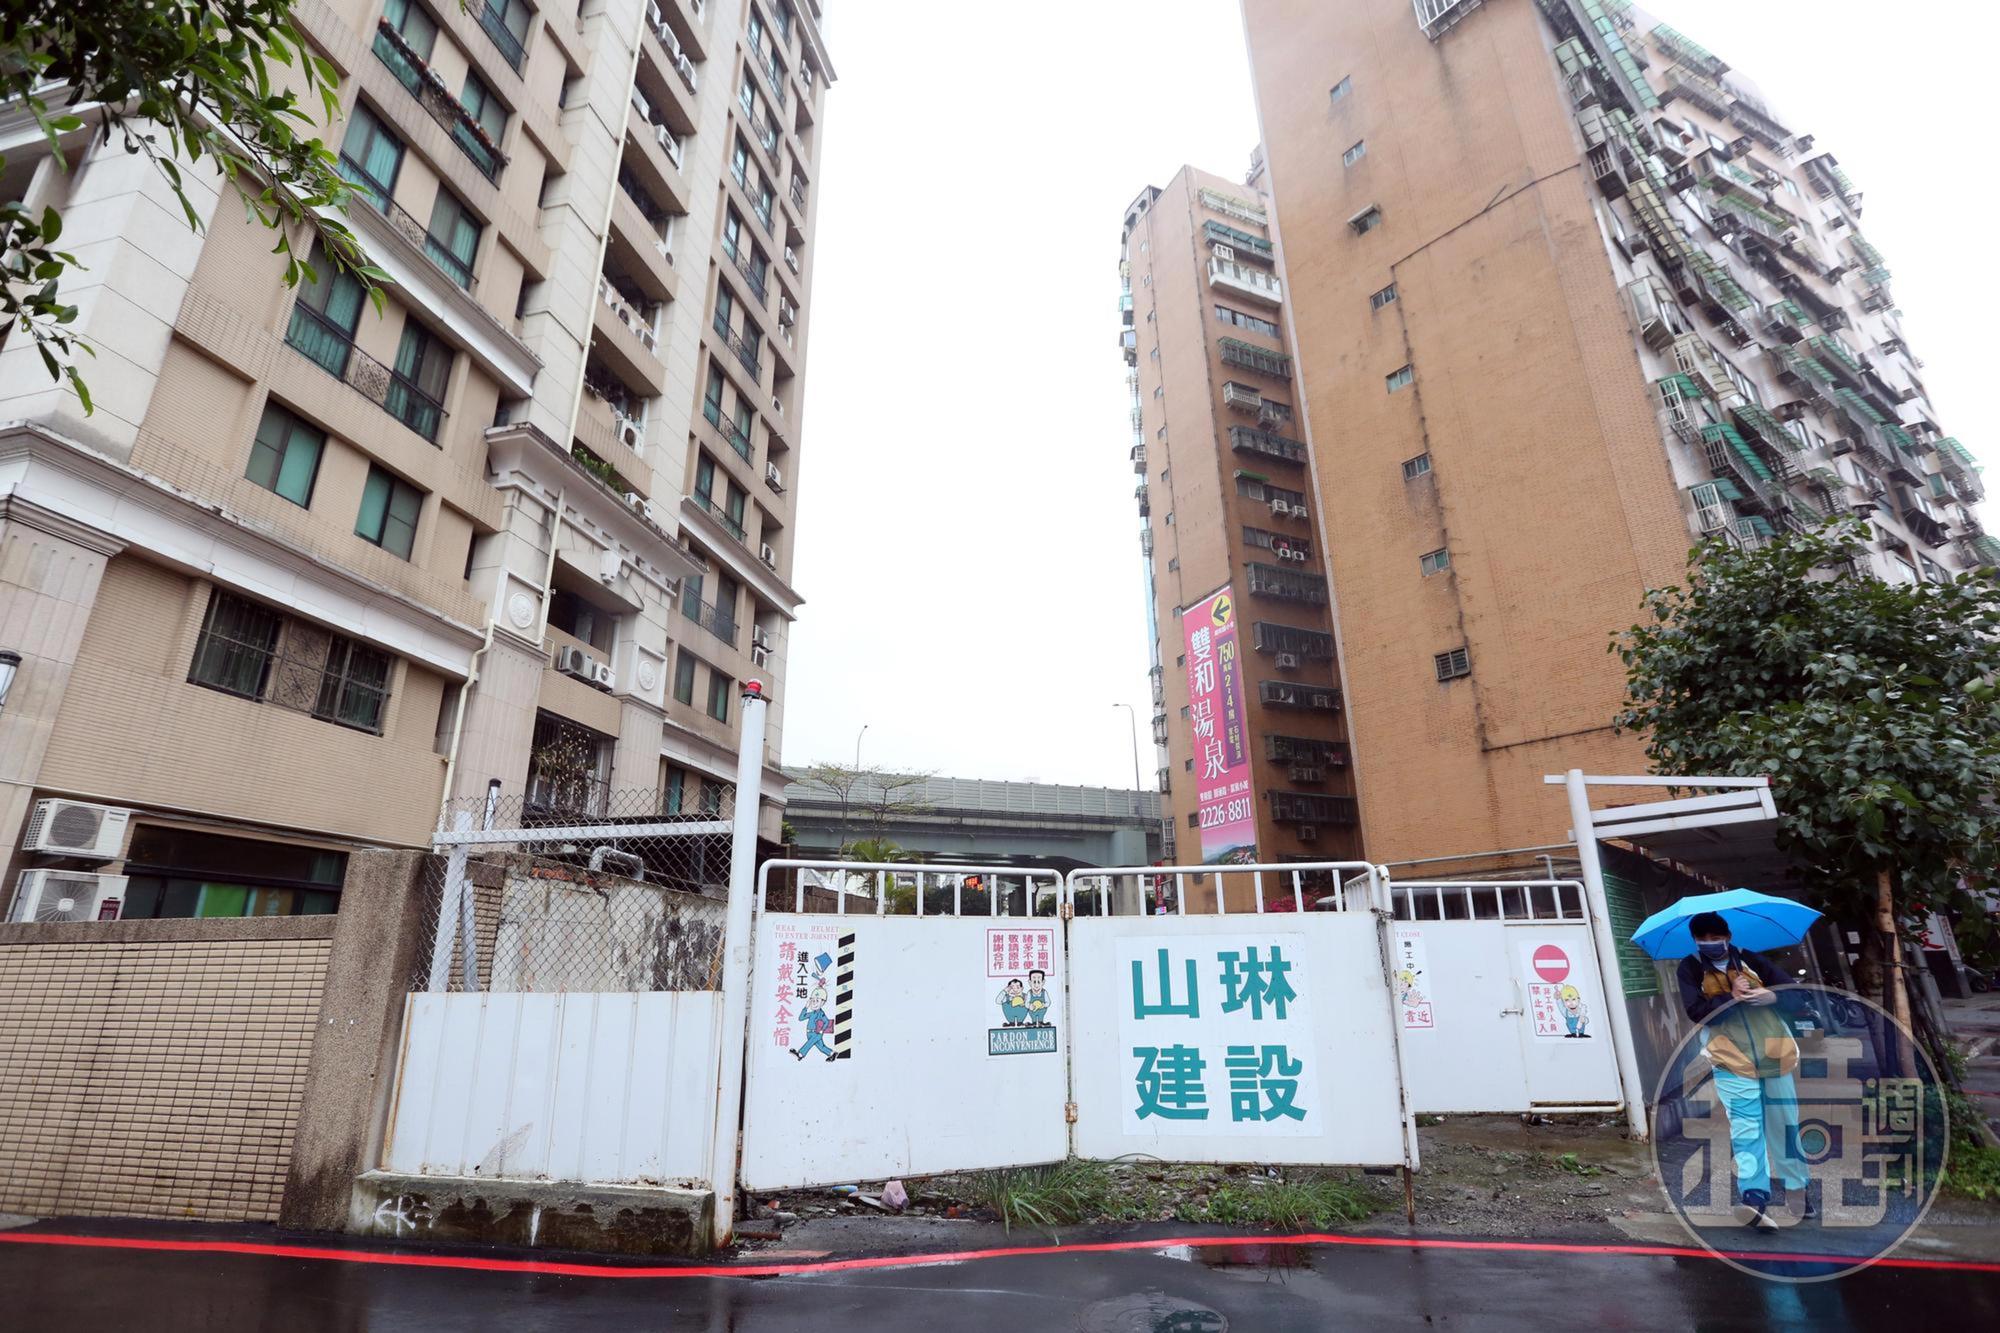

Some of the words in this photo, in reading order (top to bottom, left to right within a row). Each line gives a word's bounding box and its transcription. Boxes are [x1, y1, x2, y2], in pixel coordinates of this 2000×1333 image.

[1217, 640, 1235, 665] 750
[1191, 626, 1230, 780] 雙和湯泉
[810, 925, 839, 933] HELMET
[993, 934, 1005, 970] 謝謝合作
[1008, 934, 1020, 970] 敬請原諒
[1022, 934, 1034, 970] 諸多不便
[1037, 934, 1049, 969] 施工期間
[1404, 941, 1414, 969] 施工中
[796, 951, 809, 999] 進入工地
[1131, 945, 1297, 1021] 山琳
[773, 941, 797, 1047] 請戴安全帽
[1531, 985, 1548, 1033] 禁止進入
[990, 1031, 1028, 1042] PARDON
[1036, 1030, 1055, 1041] FOR
[990, 1039, 1055, 1052] INCONVENIENCE
[1132, 1043, 1308, 1123] 建設
